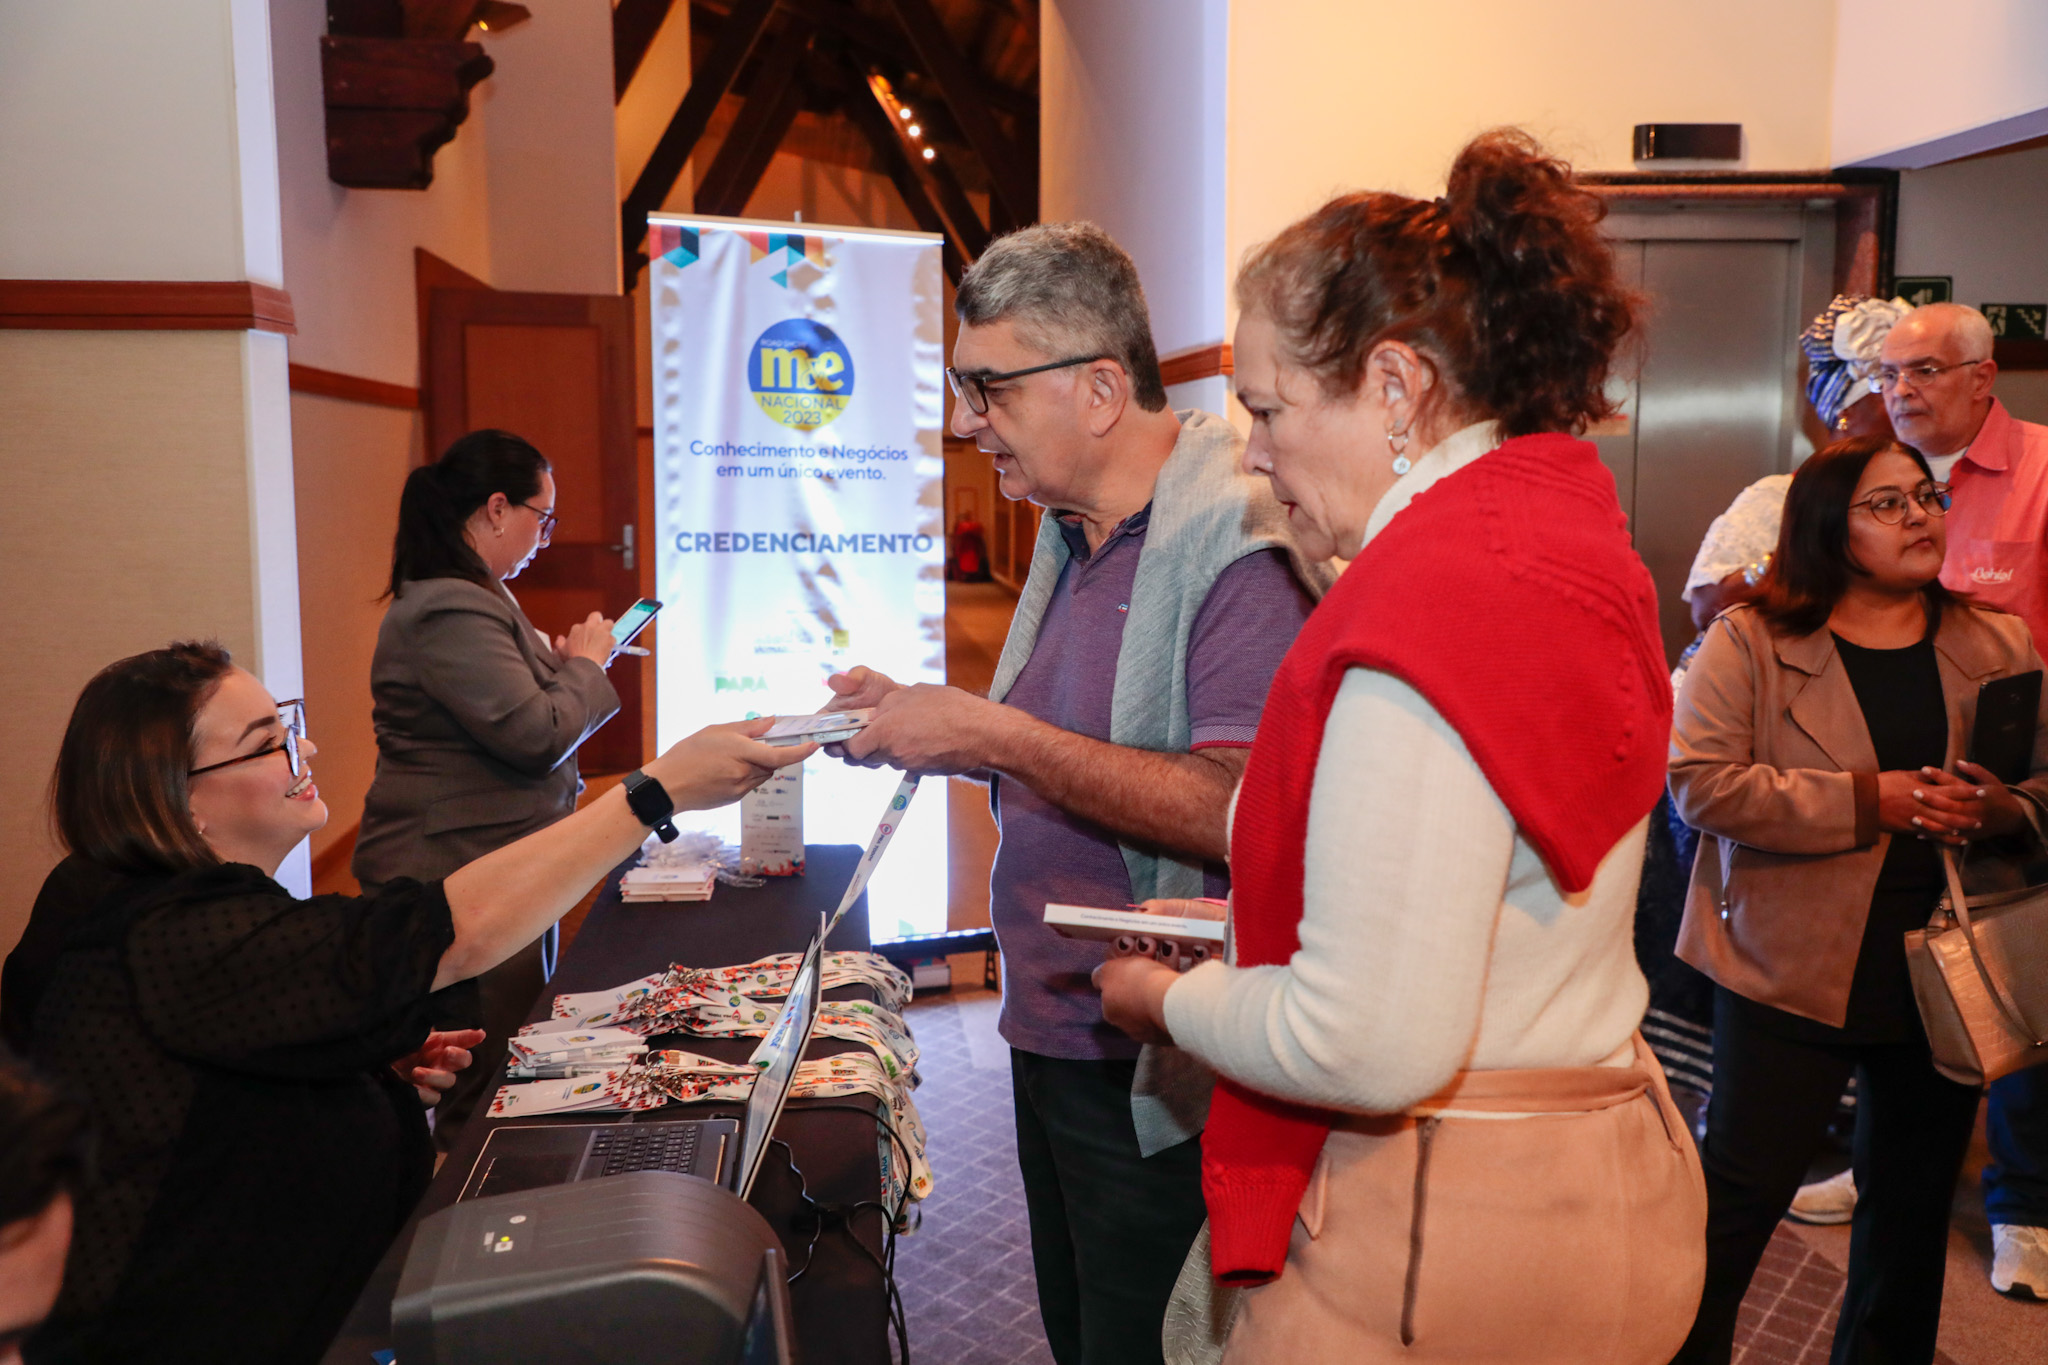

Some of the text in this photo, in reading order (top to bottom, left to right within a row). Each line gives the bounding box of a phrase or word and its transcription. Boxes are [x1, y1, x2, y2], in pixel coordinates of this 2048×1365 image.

[761, 396, 843, 410] NACIONAL
[783, 410, 822, 425] 2023
[690, 440, 908, 463] Conhecimento e Negócios
[716, 463, 887, 480] em um único evento.
[675, 531, 933, 553] CREDENCIAMENTO
